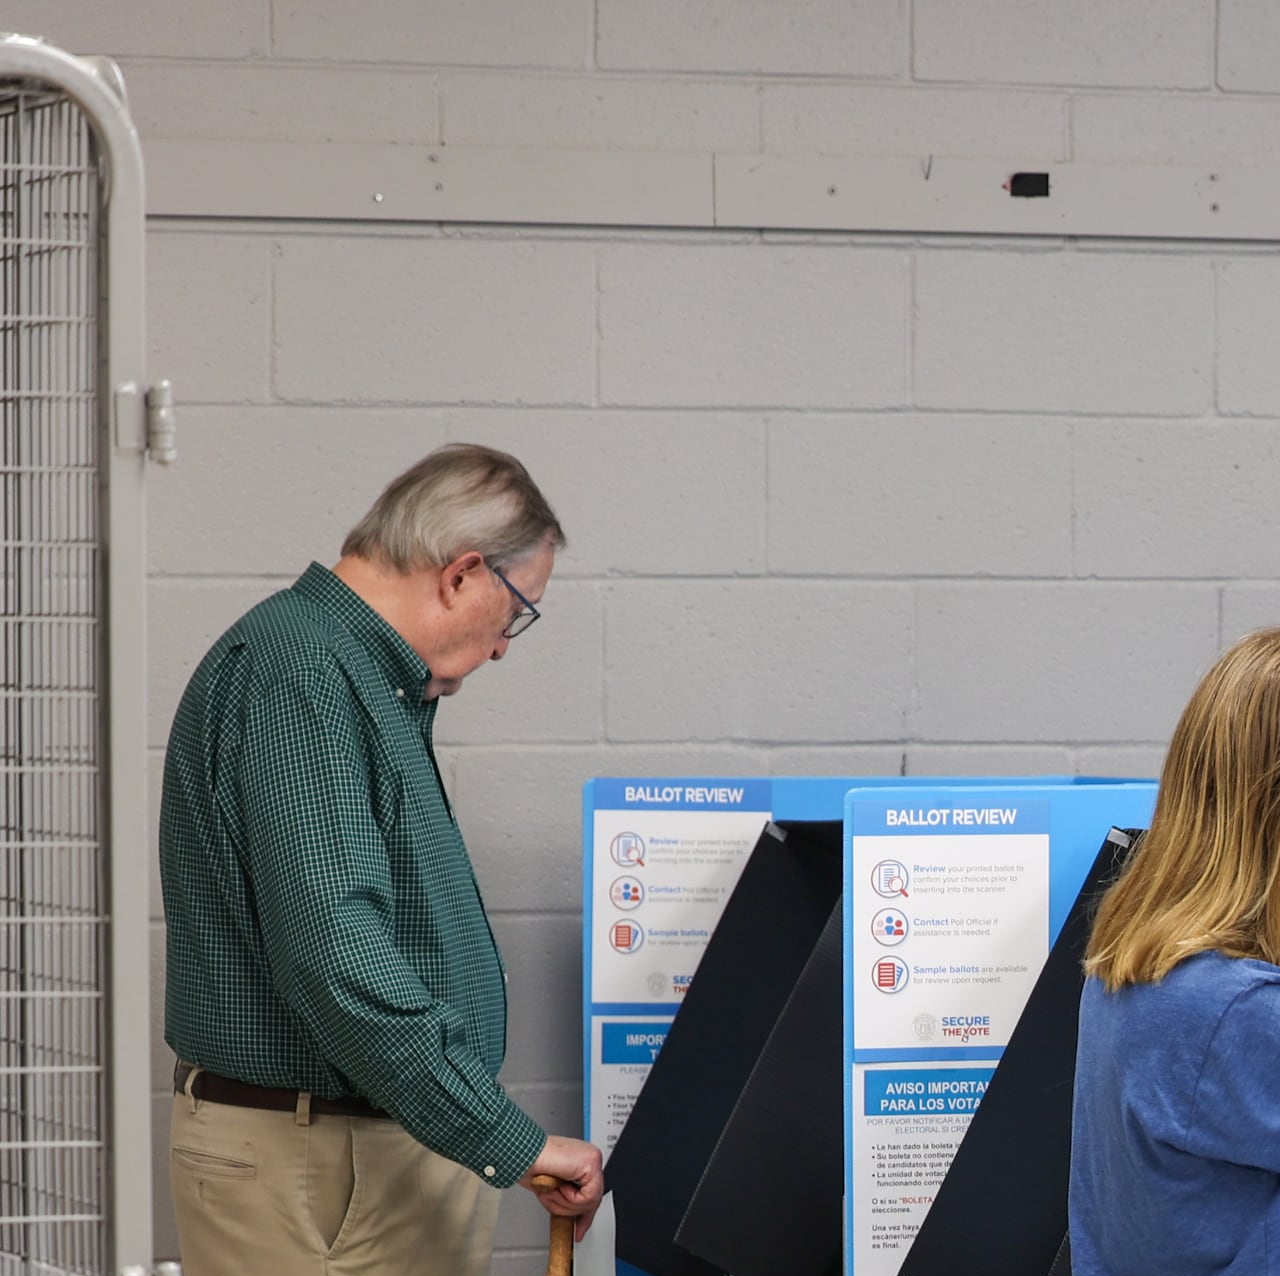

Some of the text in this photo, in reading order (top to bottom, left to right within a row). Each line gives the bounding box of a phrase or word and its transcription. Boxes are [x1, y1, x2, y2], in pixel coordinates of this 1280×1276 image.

[625, 786, 744, 804] BALLOT REVIEW
[886, 808, 1018, 826] BALLOT REVIEW
[913, 864, 946, 873] Review
[947, 866, 966, 874] your
[966, 864, 992, 874] printed
[993, 864, 1016, 873] ballot
[913, 875, 941, 884] confirm
[942, 876, 960, 885] your
[960, 875, 989, 883] choices
[990, 875, 1009, 884] prior
[913, 885, 946, 895] inserting
[946, 886, 961, 894] into
[962, 885, 975, 893] the
[913, 917, 999, 927] Contact Poll Official if
[913, 929, 952, 937] assistance
[953, 928, 959, 936] is
[913, 965, 947, 975] Sample
[949, 965, 980, 973] ballots
[995, 965, 1028, 973] available
[672, 975, 694, 985] SEC
[913, 976, 924, 985] for
[951, 977, 971, 985] upon
[942, 1016, 990, 1026] SECURE
[942, 1028, 962, 1037] THE
[626, 1033, 668, 1046] IMPOR
[885, 1081, 990, 1095] AVISO IMPORTA
[880, 1097, 981, 1112] PARA LOS VOTA
[866, 1118, 884, 1126] POR
[885, 1118, 912, 1126] FAVOR
[912, 1117, 954, 1125] NOTIFICAR
[955, 1116, 961, 1124] A
[895, 1126, 940, 1134] ELECTORAL
[928, 1161, 942, 1169] que
[876, 1180, 922, 1188] funcionando
[902, 1224, 920, 1232] haya
